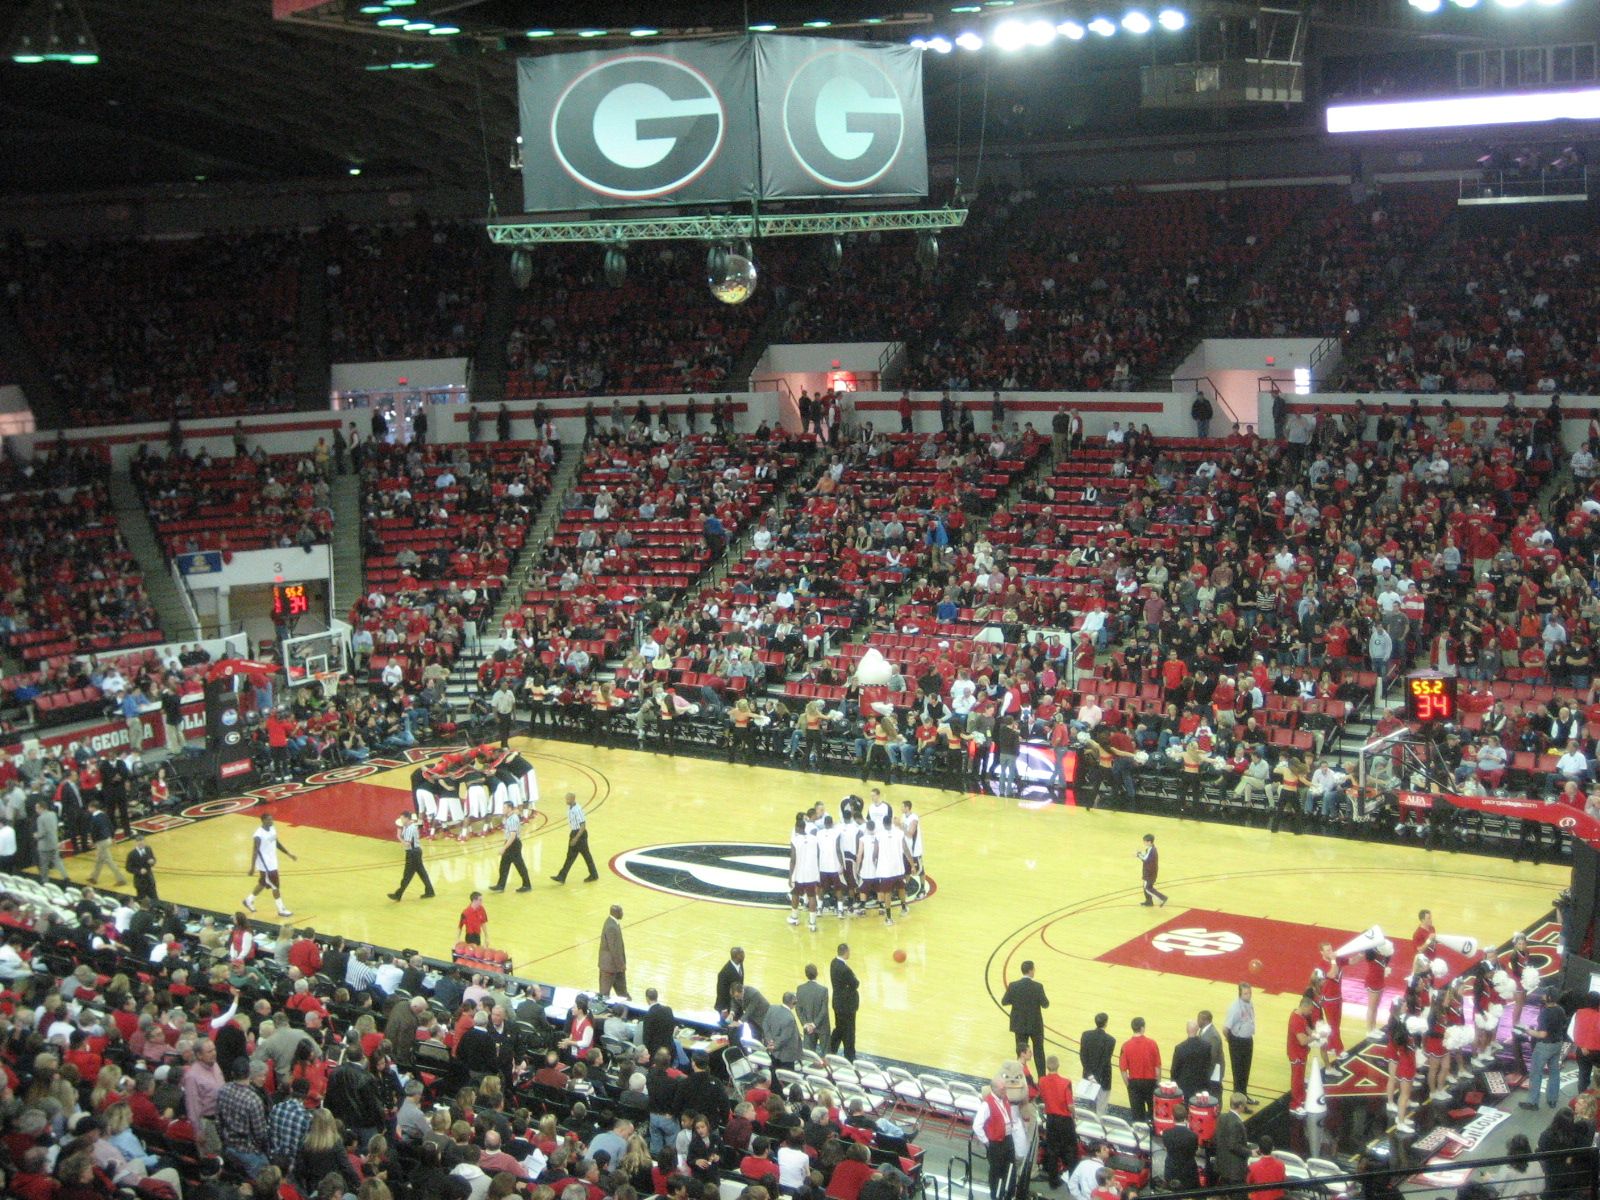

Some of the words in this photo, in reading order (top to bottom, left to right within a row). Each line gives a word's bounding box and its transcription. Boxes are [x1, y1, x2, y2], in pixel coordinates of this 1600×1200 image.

[551, 53, 726, 199] G
[784, 49, 904, 189] G
[273, 562, 283, 573] 3
[285, 586, 304, 598] 55.2
[290, 596, 308, 614] 34
[1412, 680, 1443, 695] 55.2
[1418, 695, 1447, 719] 34
[1406, 795, 1425, 804] ALFA
